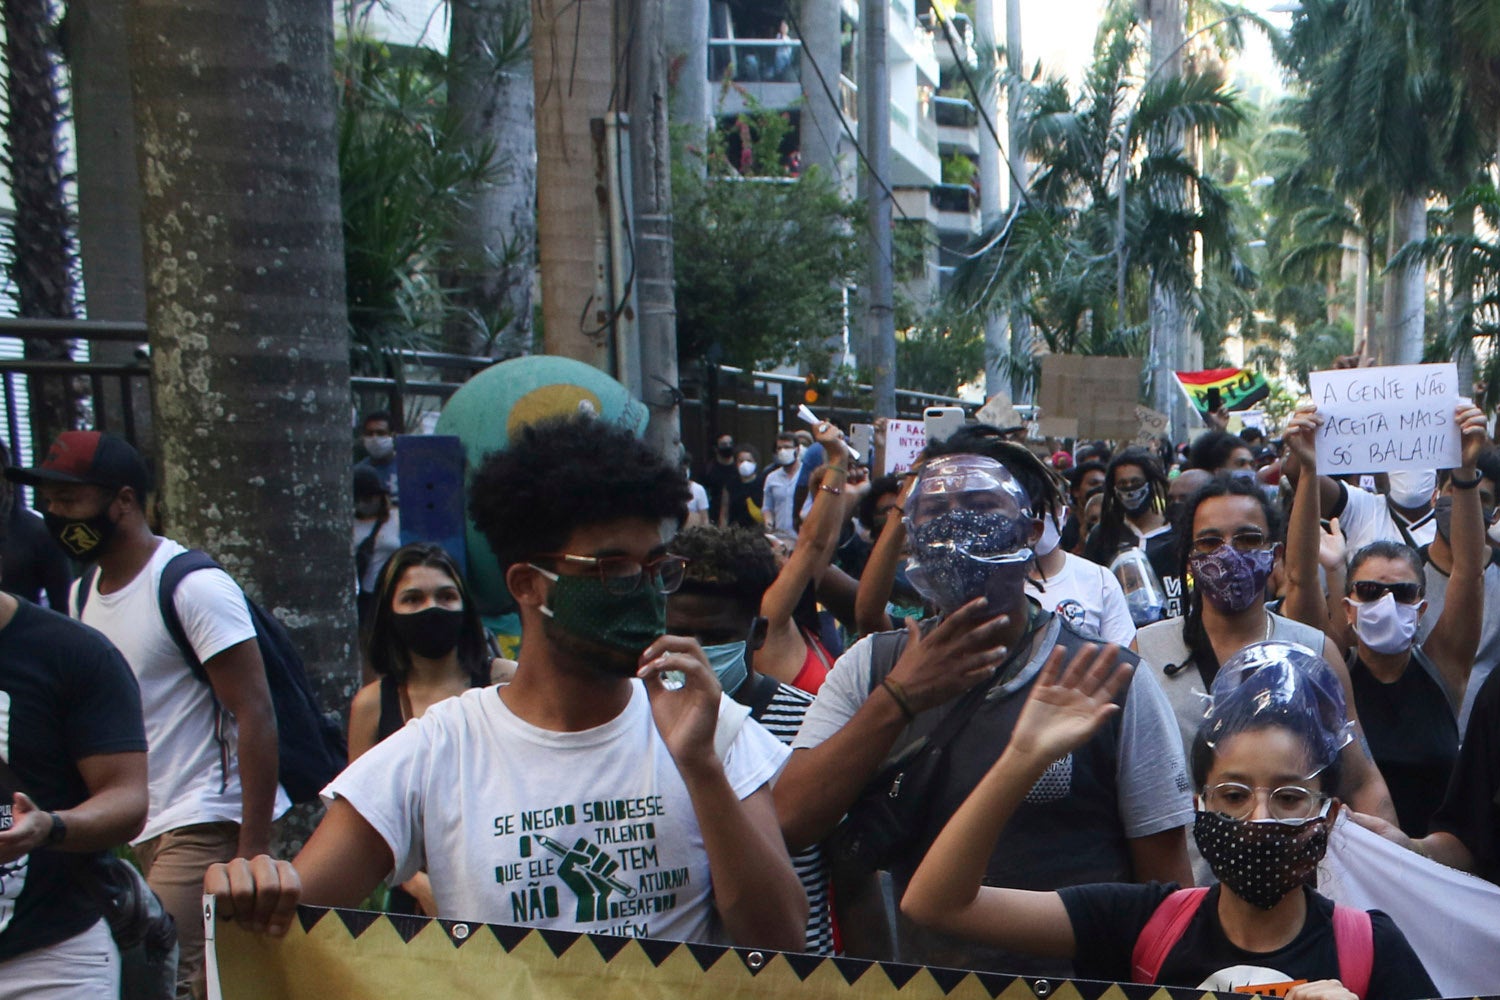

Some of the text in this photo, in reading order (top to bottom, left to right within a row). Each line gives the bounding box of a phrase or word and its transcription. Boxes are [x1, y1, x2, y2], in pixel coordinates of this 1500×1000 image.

[1323, 372, 1446, 404] A GENTE NÃO
[1400, 409, 1447, 432] MAIS
[494, 796, 665, 836] SE NEGRO SOUBESSE
[594, 822, 656, 844] TALENTO
[495, 845, 660, 885] QUE ELE TEM
[511, 867, 690, 923] NÃO ATURAVA
[610, 893, 676, 919] DESAFORO
